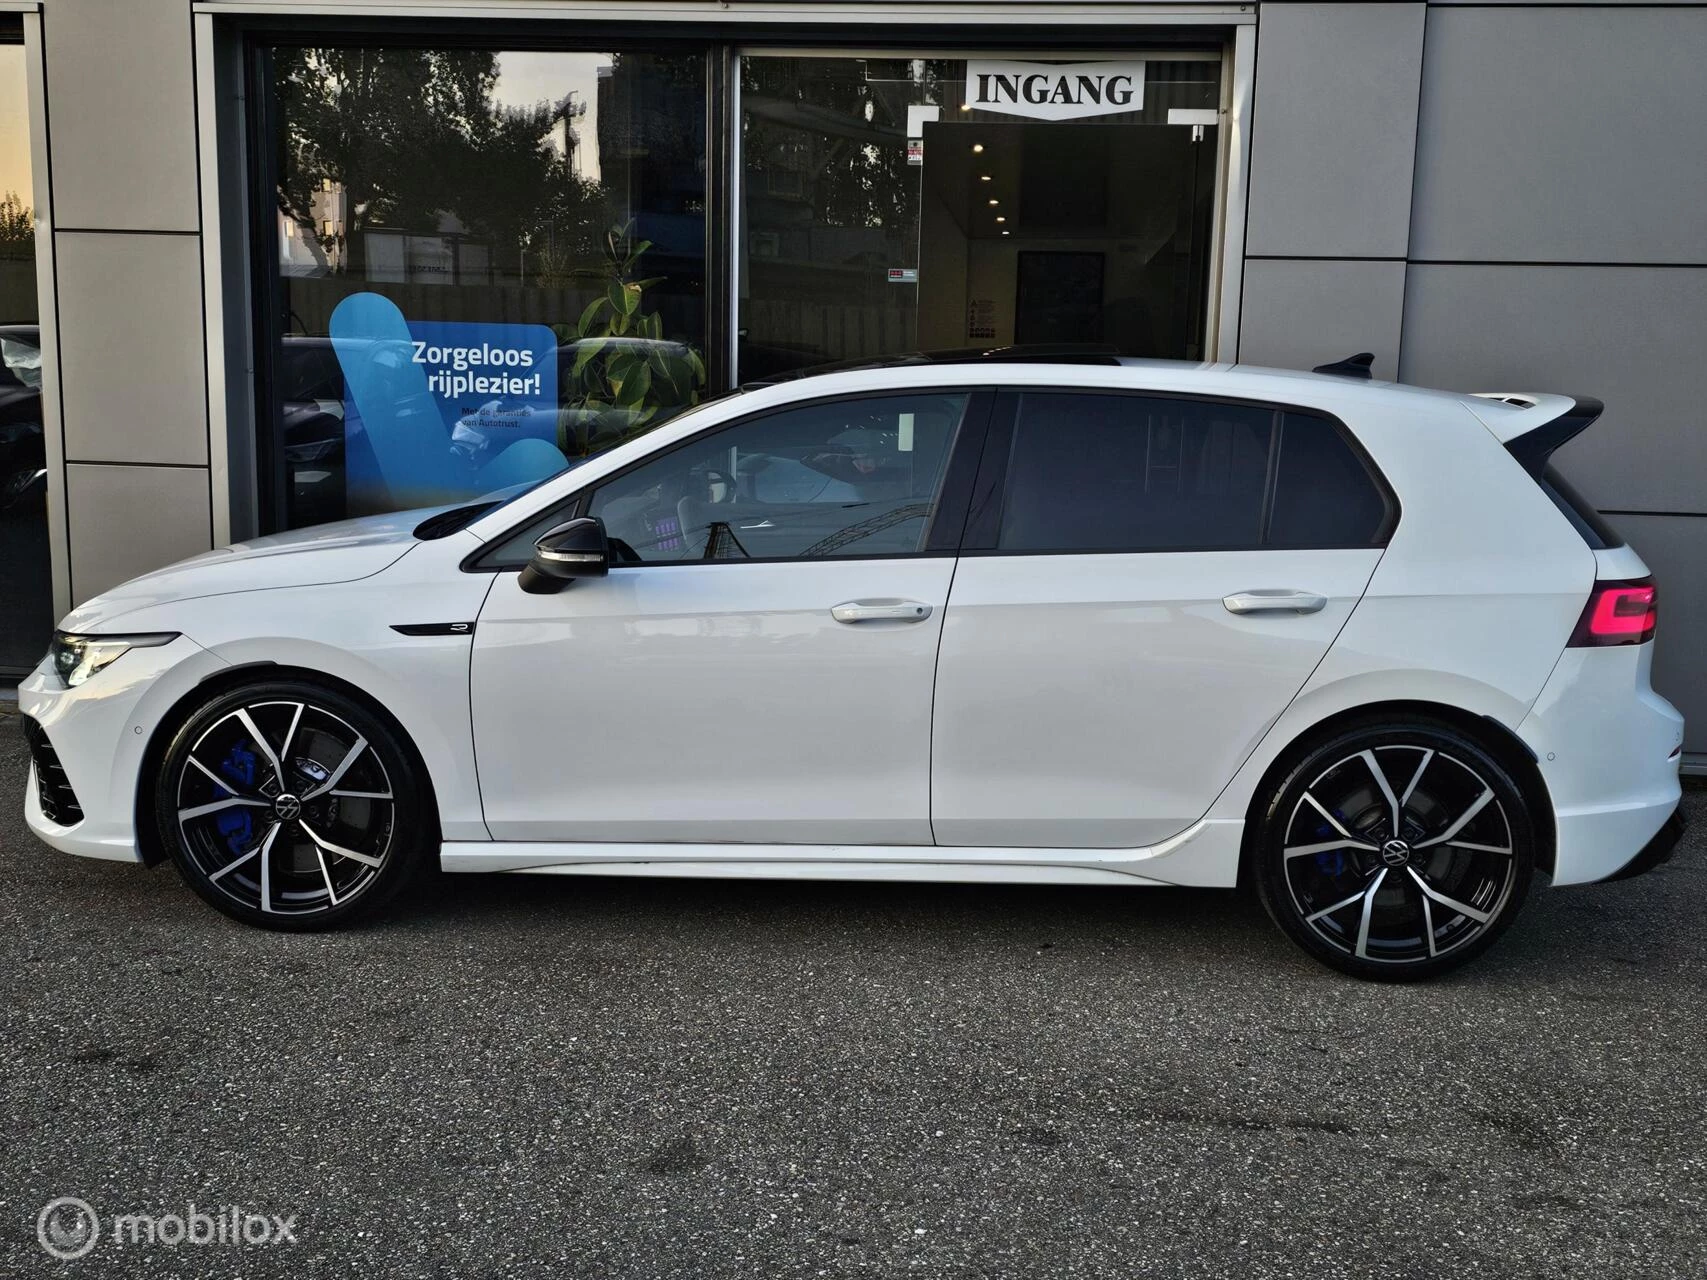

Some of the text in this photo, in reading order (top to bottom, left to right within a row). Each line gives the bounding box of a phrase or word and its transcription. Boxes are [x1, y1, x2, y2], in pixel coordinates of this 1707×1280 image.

[976, 74, 1134, 105] INGANG
[411, 341, 533, 371] Zorgeloos
[428, 370, 540, 399] rijplezier!
[481, 408, 491, 417] de
